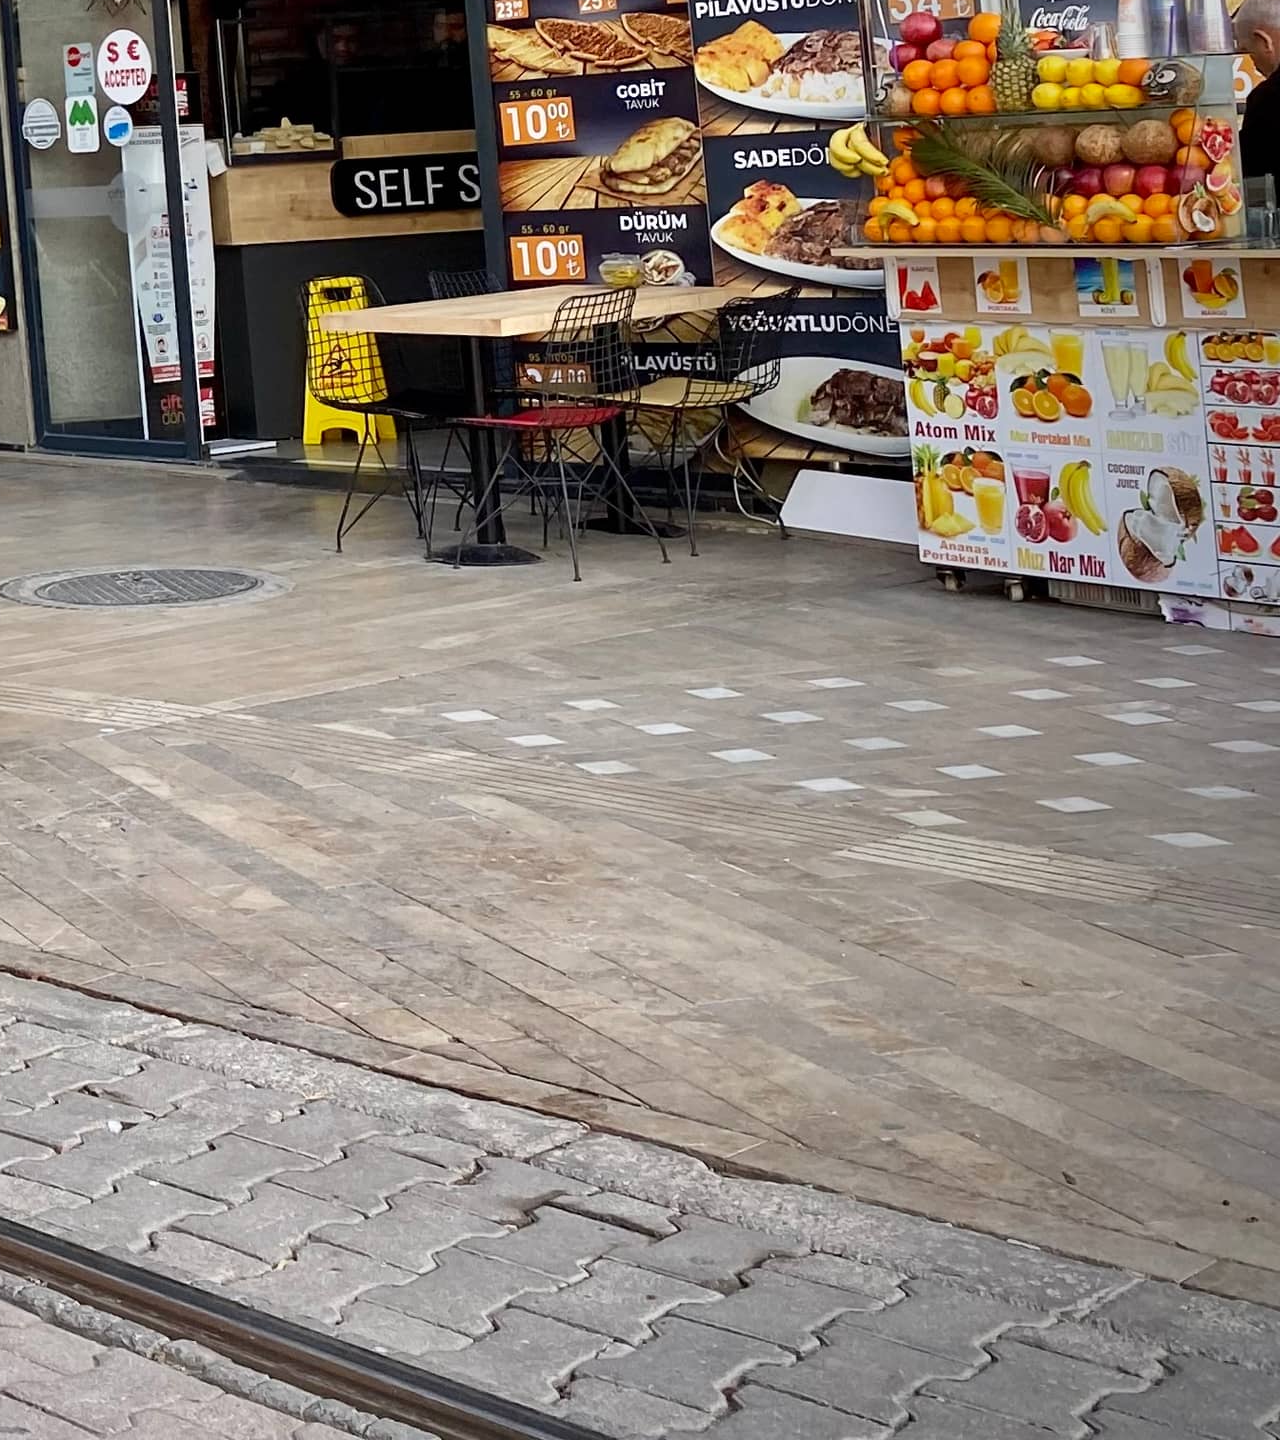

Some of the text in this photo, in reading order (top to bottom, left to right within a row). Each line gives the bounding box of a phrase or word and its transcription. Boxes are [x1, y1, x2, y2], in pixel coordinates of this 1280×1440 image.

[127, 39, 140, 61] €
[104, 68, 147, 88] ACCEPTED
[616, 78, 666, 99] GOBİT
[624, 98, 661, 111] TAVUK
[354, 166, 445, 210] SELF
[620, 211, 688, 231] DÜRÜM
[635, 232, 674, 244] TAVUK
[915, 421, 997, 442] Atom Mix
[1031, 431, 1071, 446] Portakal
[1072, 435, 1091, 448] Mix
[1107, 463, 1146, 476] COCONUT
[1116, 478, 1141, 490] JUICE
[940, 540, 990, 556] Ananas
[922, 549, 1009, 569] Portakal Mix
[1017, 547, 1107, 579] Muz Nar Mix
